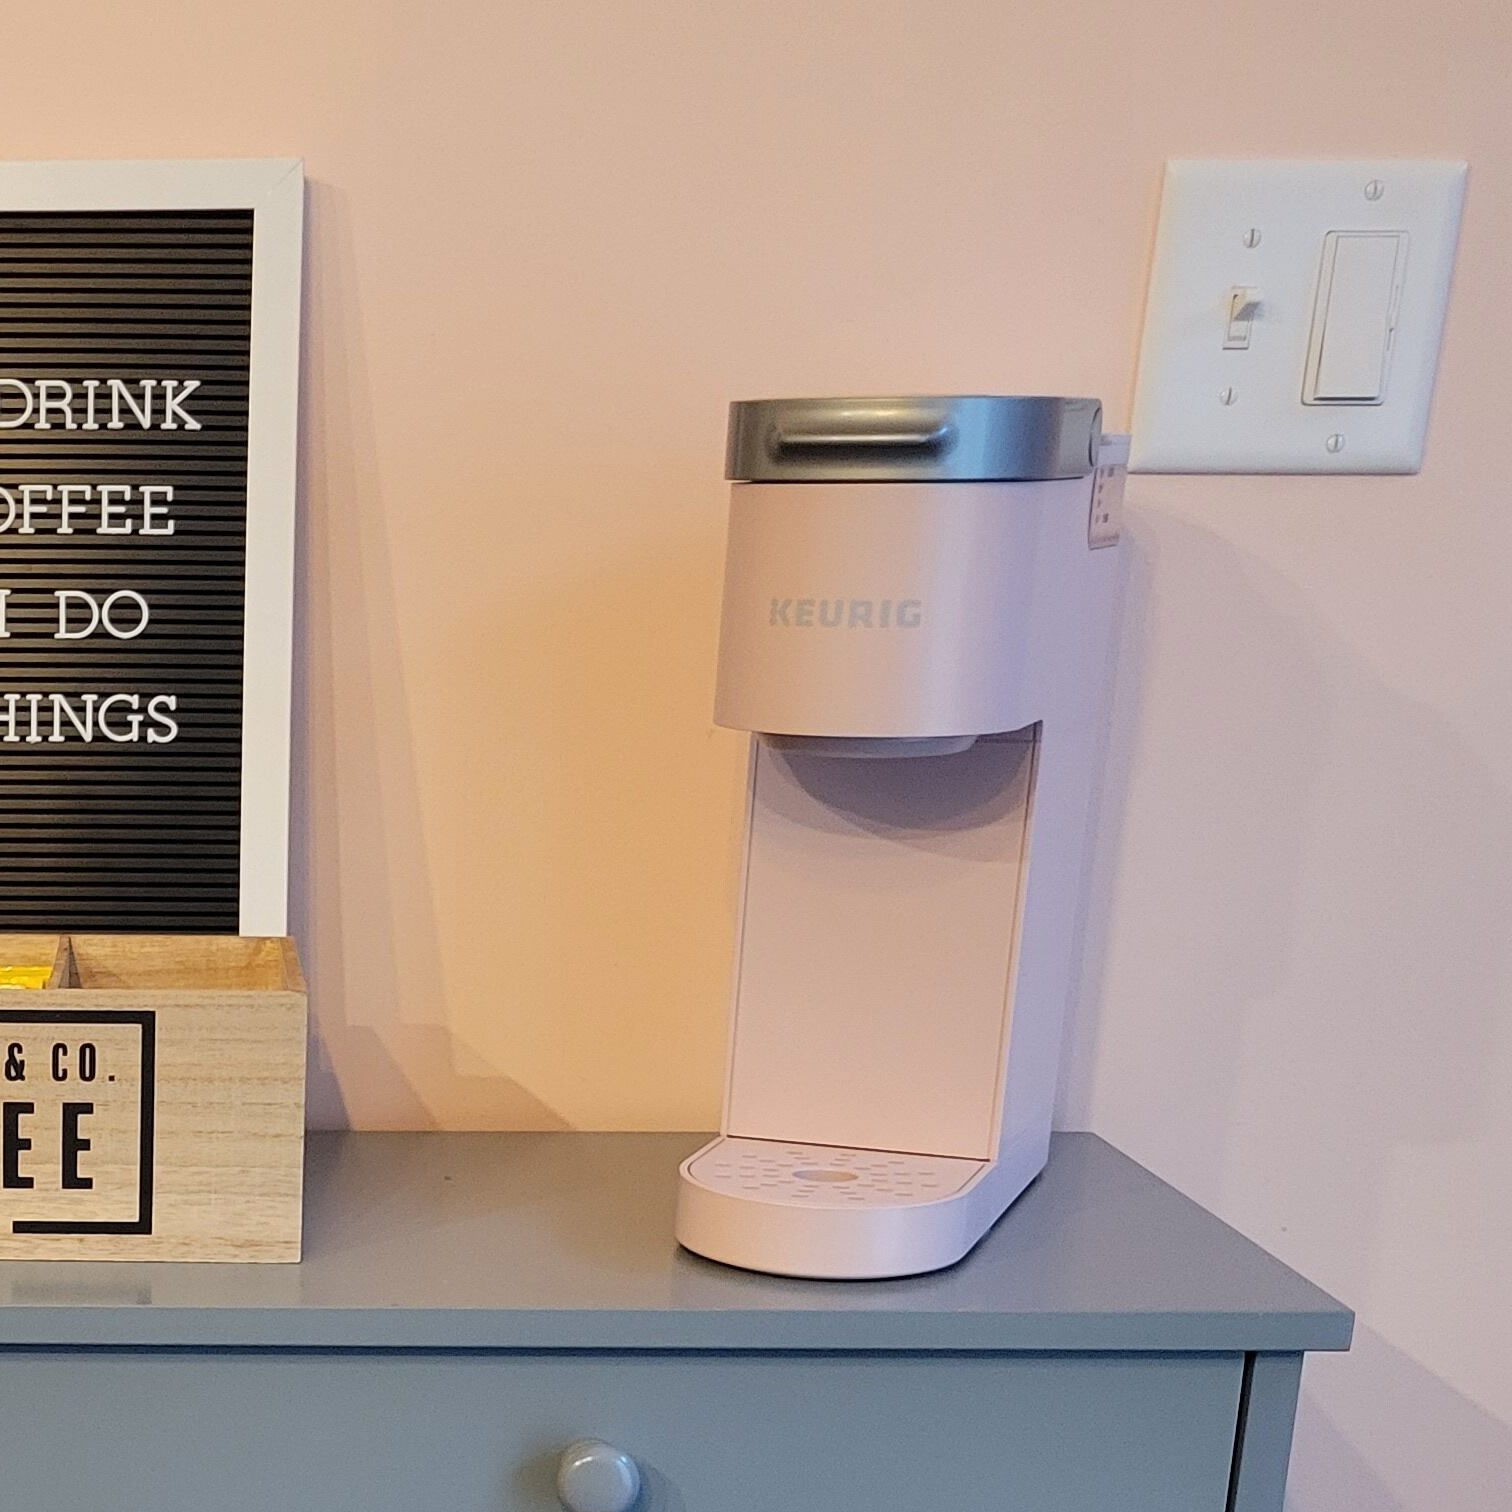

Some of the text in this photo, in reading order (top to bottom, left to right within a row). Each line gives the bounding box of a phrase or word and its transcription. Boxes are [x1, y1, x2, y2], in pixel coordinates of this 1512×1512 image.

[54, 590, 149, 639] DO
[769, 598, 923, 629] KEURIG
[4, 1042, 26, 1082] &
[51, 1042, 118, 1083] CO.
